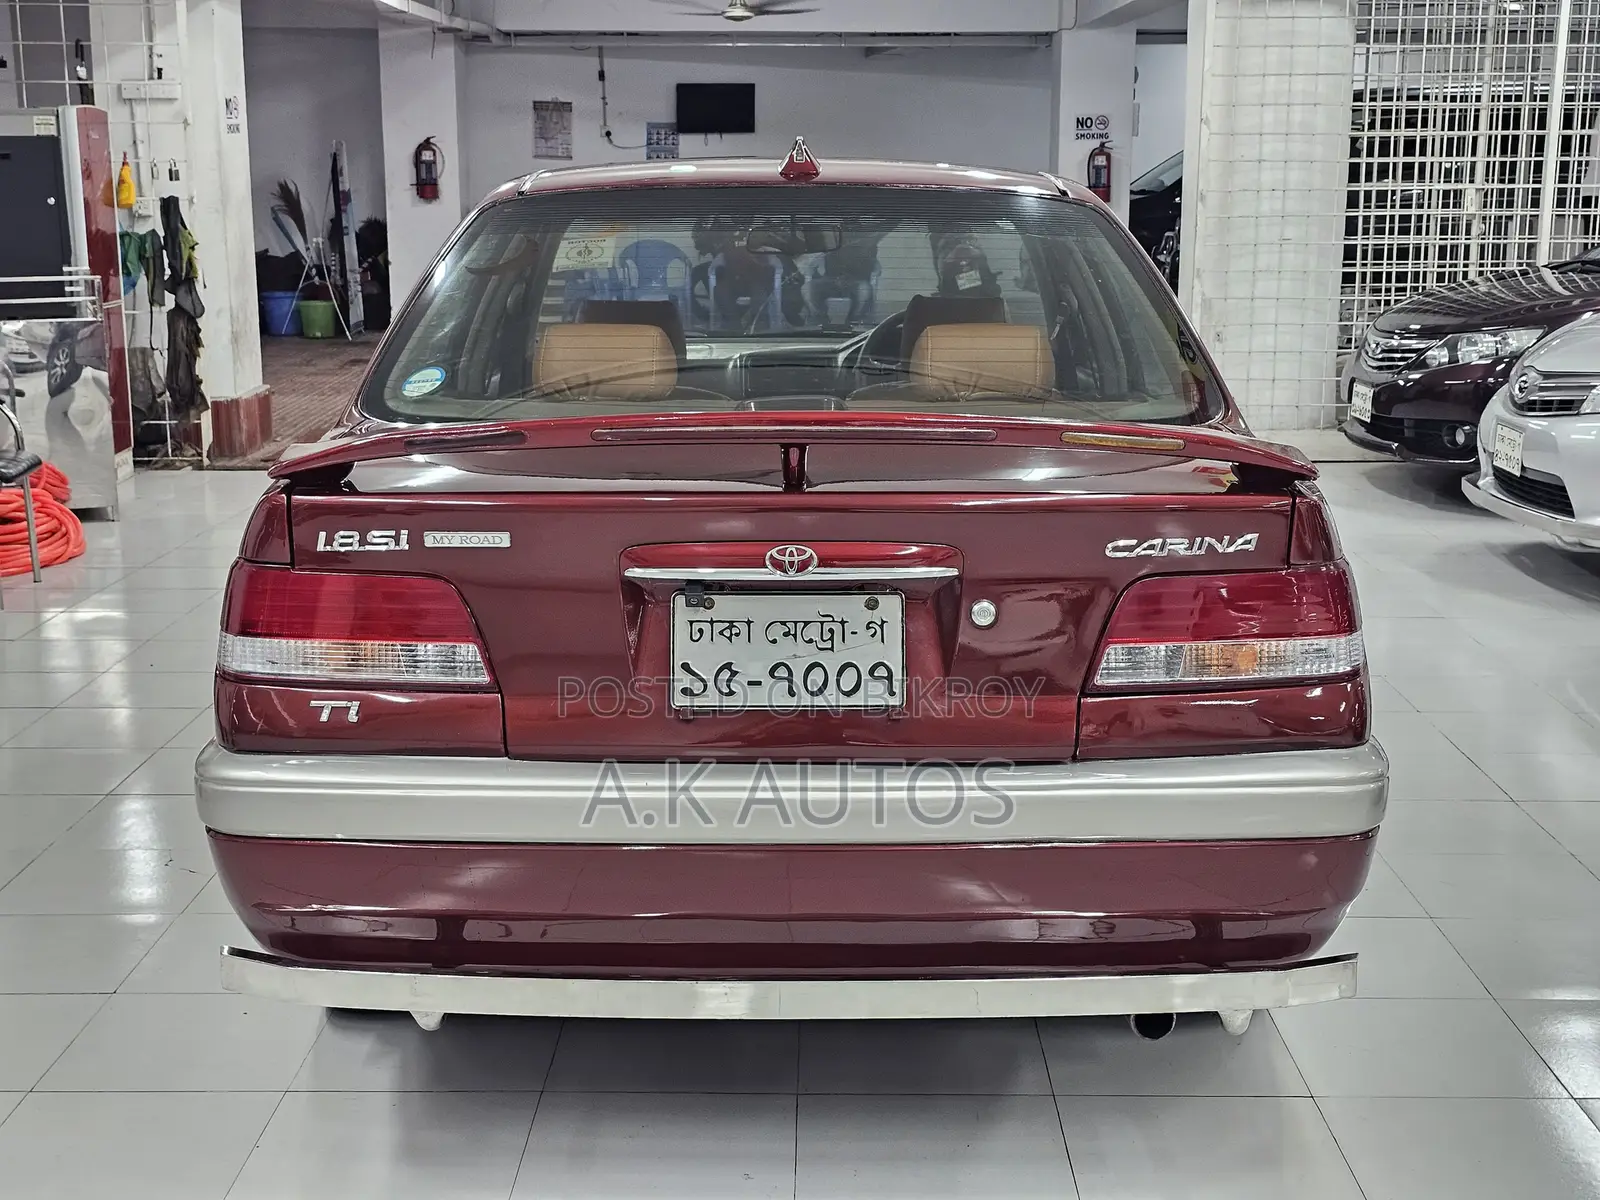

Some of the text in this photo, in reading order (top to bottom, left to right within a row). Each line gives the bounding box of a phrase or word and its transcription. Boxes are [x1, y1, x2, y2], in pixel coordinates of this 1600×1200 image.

[1076, 116, 1093, 129] NO
[1075, 132, 1109, 140] SMOKING
[431, 535, 504, 545] MY ROAD
[1105, 532, 1260, 558] CARINA
[686, 618, 754, 644] ঢাকা
[679, 660, 898, 699] ১৫-৭০০৭
